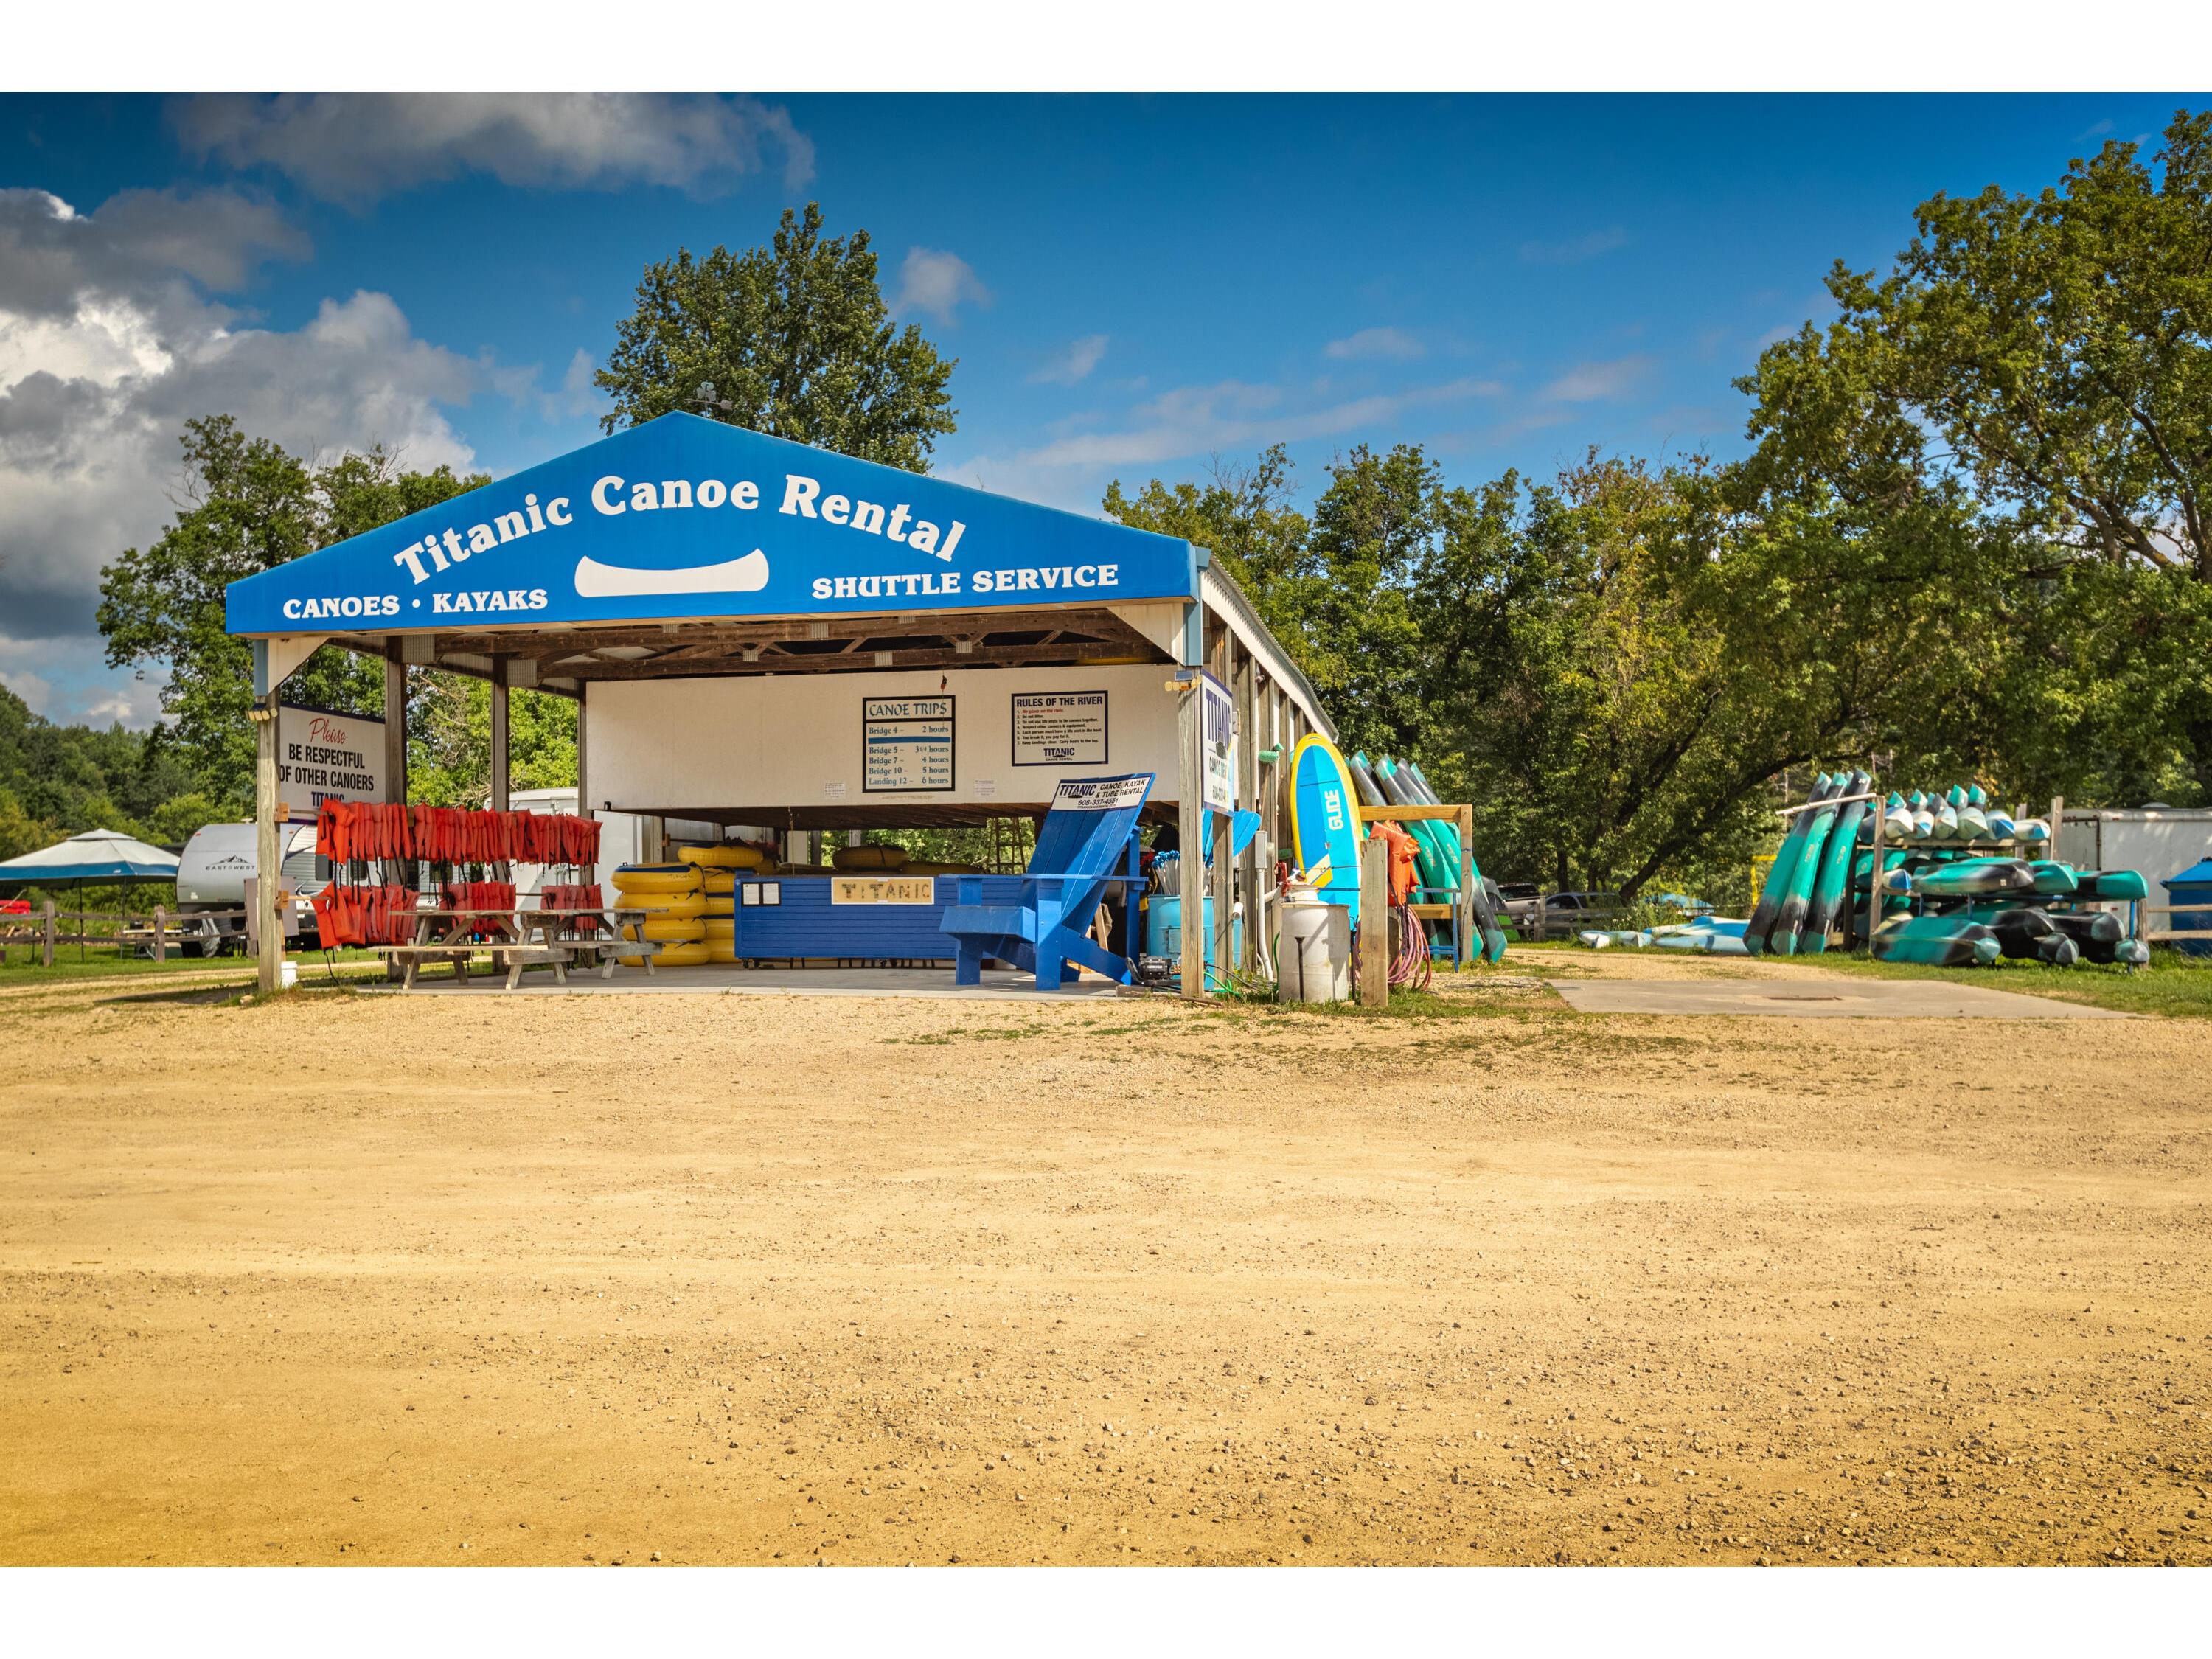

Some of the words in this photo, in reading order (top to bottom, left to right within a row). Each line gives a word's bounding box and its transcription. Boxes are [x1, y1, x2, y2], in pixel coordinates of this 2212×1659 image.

[393, 493, 572, 585] Titanic
[591, 476, 759, 515] Canoe
[779, 474, 967, 562] Rental
[812, 572, 961, 599] SHUTTLE
[972, 564, 1119, 592] SERVICE
[282, 595, 400, 619] CANOES
[433, 589, 548, 613] KAYAKS
[1016, 698, 1043, 707] RULES
[1046, 698, 1057, 706] OF
[1059, 697, 1075, 706] THE
[1077, 696, 1102, 705] RIVER
[869, 703, 909, 716] CANOE
[913, 702, 947, 715] TRIPS
[309, 717, 347, 744] Please
[869, 727, 891, 736] Bridge
[289, 743, 302, 761] BE
[305, 745, 365, 769] RESPECTFUL
[869, 747, 891, 756] Bridge
[1043, 748, 1075, 757] TITANIC
[869, 757, 891, 766] Bridge
[869, 768, 891, 776] Bridge
[280, 765, 291, 782] OF
[295, 767, 327, 786] OTHER
[330, 771, 374, 791] CANOERS
[869, 778, 897, 786] Landing
[1059, 785, 1096, 796] TITANIC
[1102, 790, 1119, 798] TUBE
[1120, 787, 1143, 796] RENTAL
[1324, 789, 1344, 831] GLIDE
